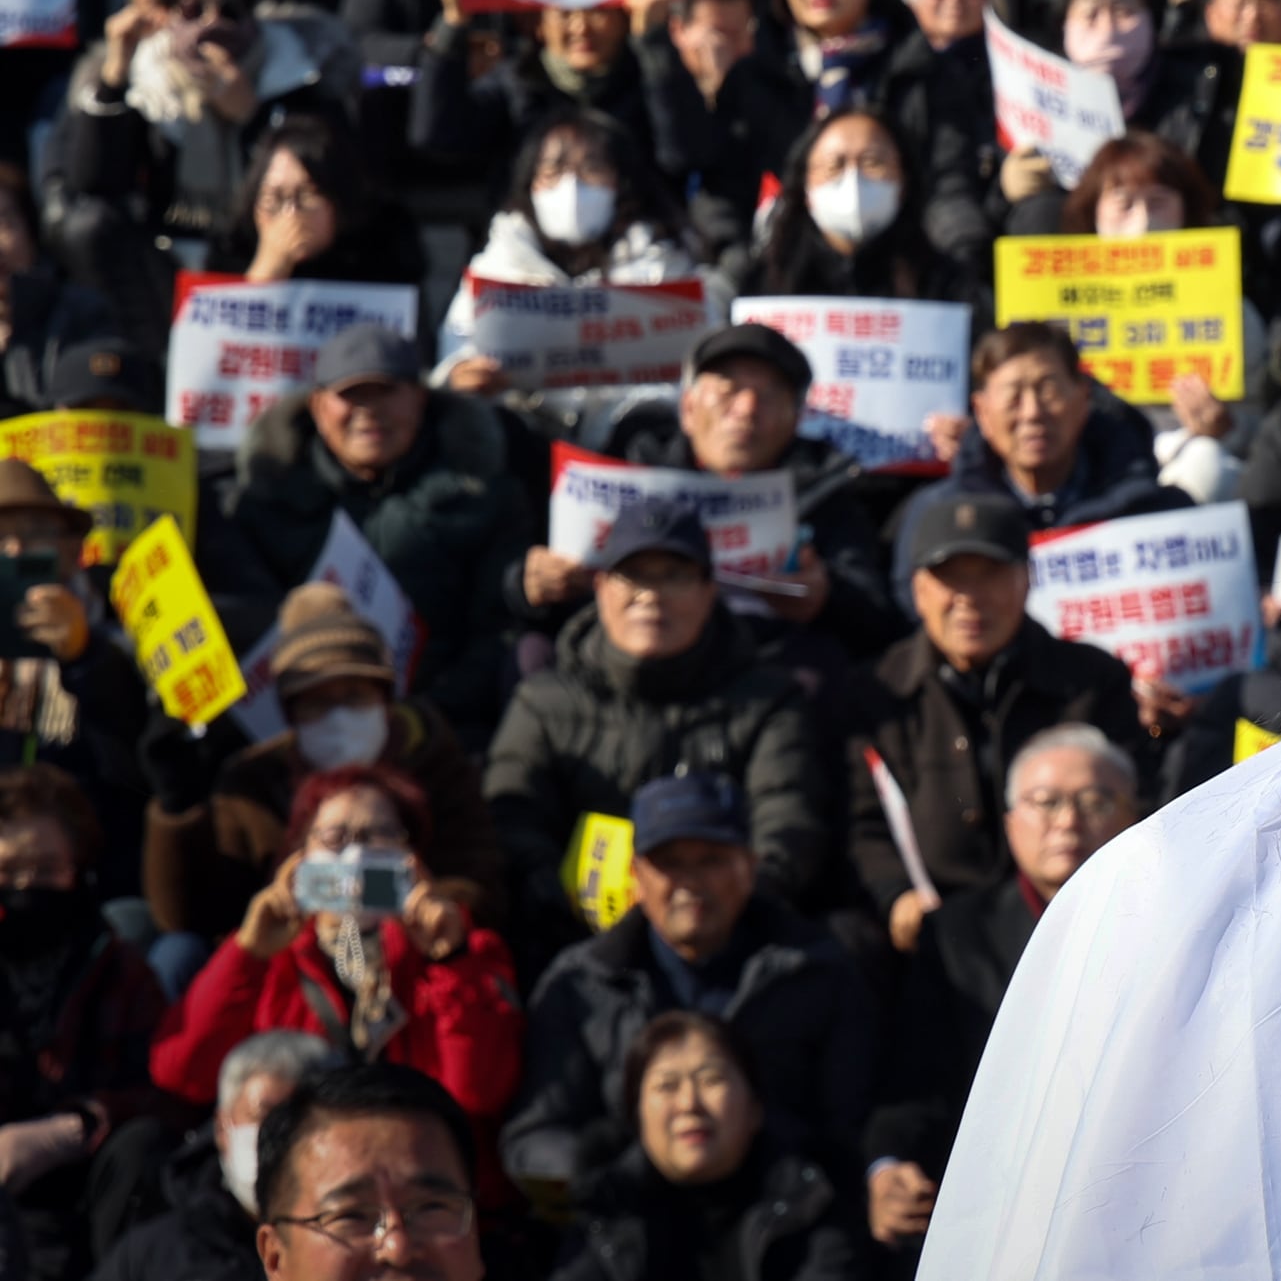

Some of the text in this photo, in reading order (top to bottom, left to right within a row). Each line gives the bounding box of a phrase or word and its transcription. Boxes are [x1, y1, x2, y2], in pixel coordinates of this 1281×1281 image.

[1021, 243, 1217, 280] 강원도민의 삶을
[825, 307, 902, 343] 특별은
[1124, 320, 1165, 349] 3차
[1179, 317, 1224, 344] 개정
[218, 340, 318, 381] 강원특
[836, 343, 894, 379] 필요
[180, 390, 234, 429] 당장
[1134, 533, 1241, 571] 차별하나
[1057, 579, 1210, 641] 강원특별법
